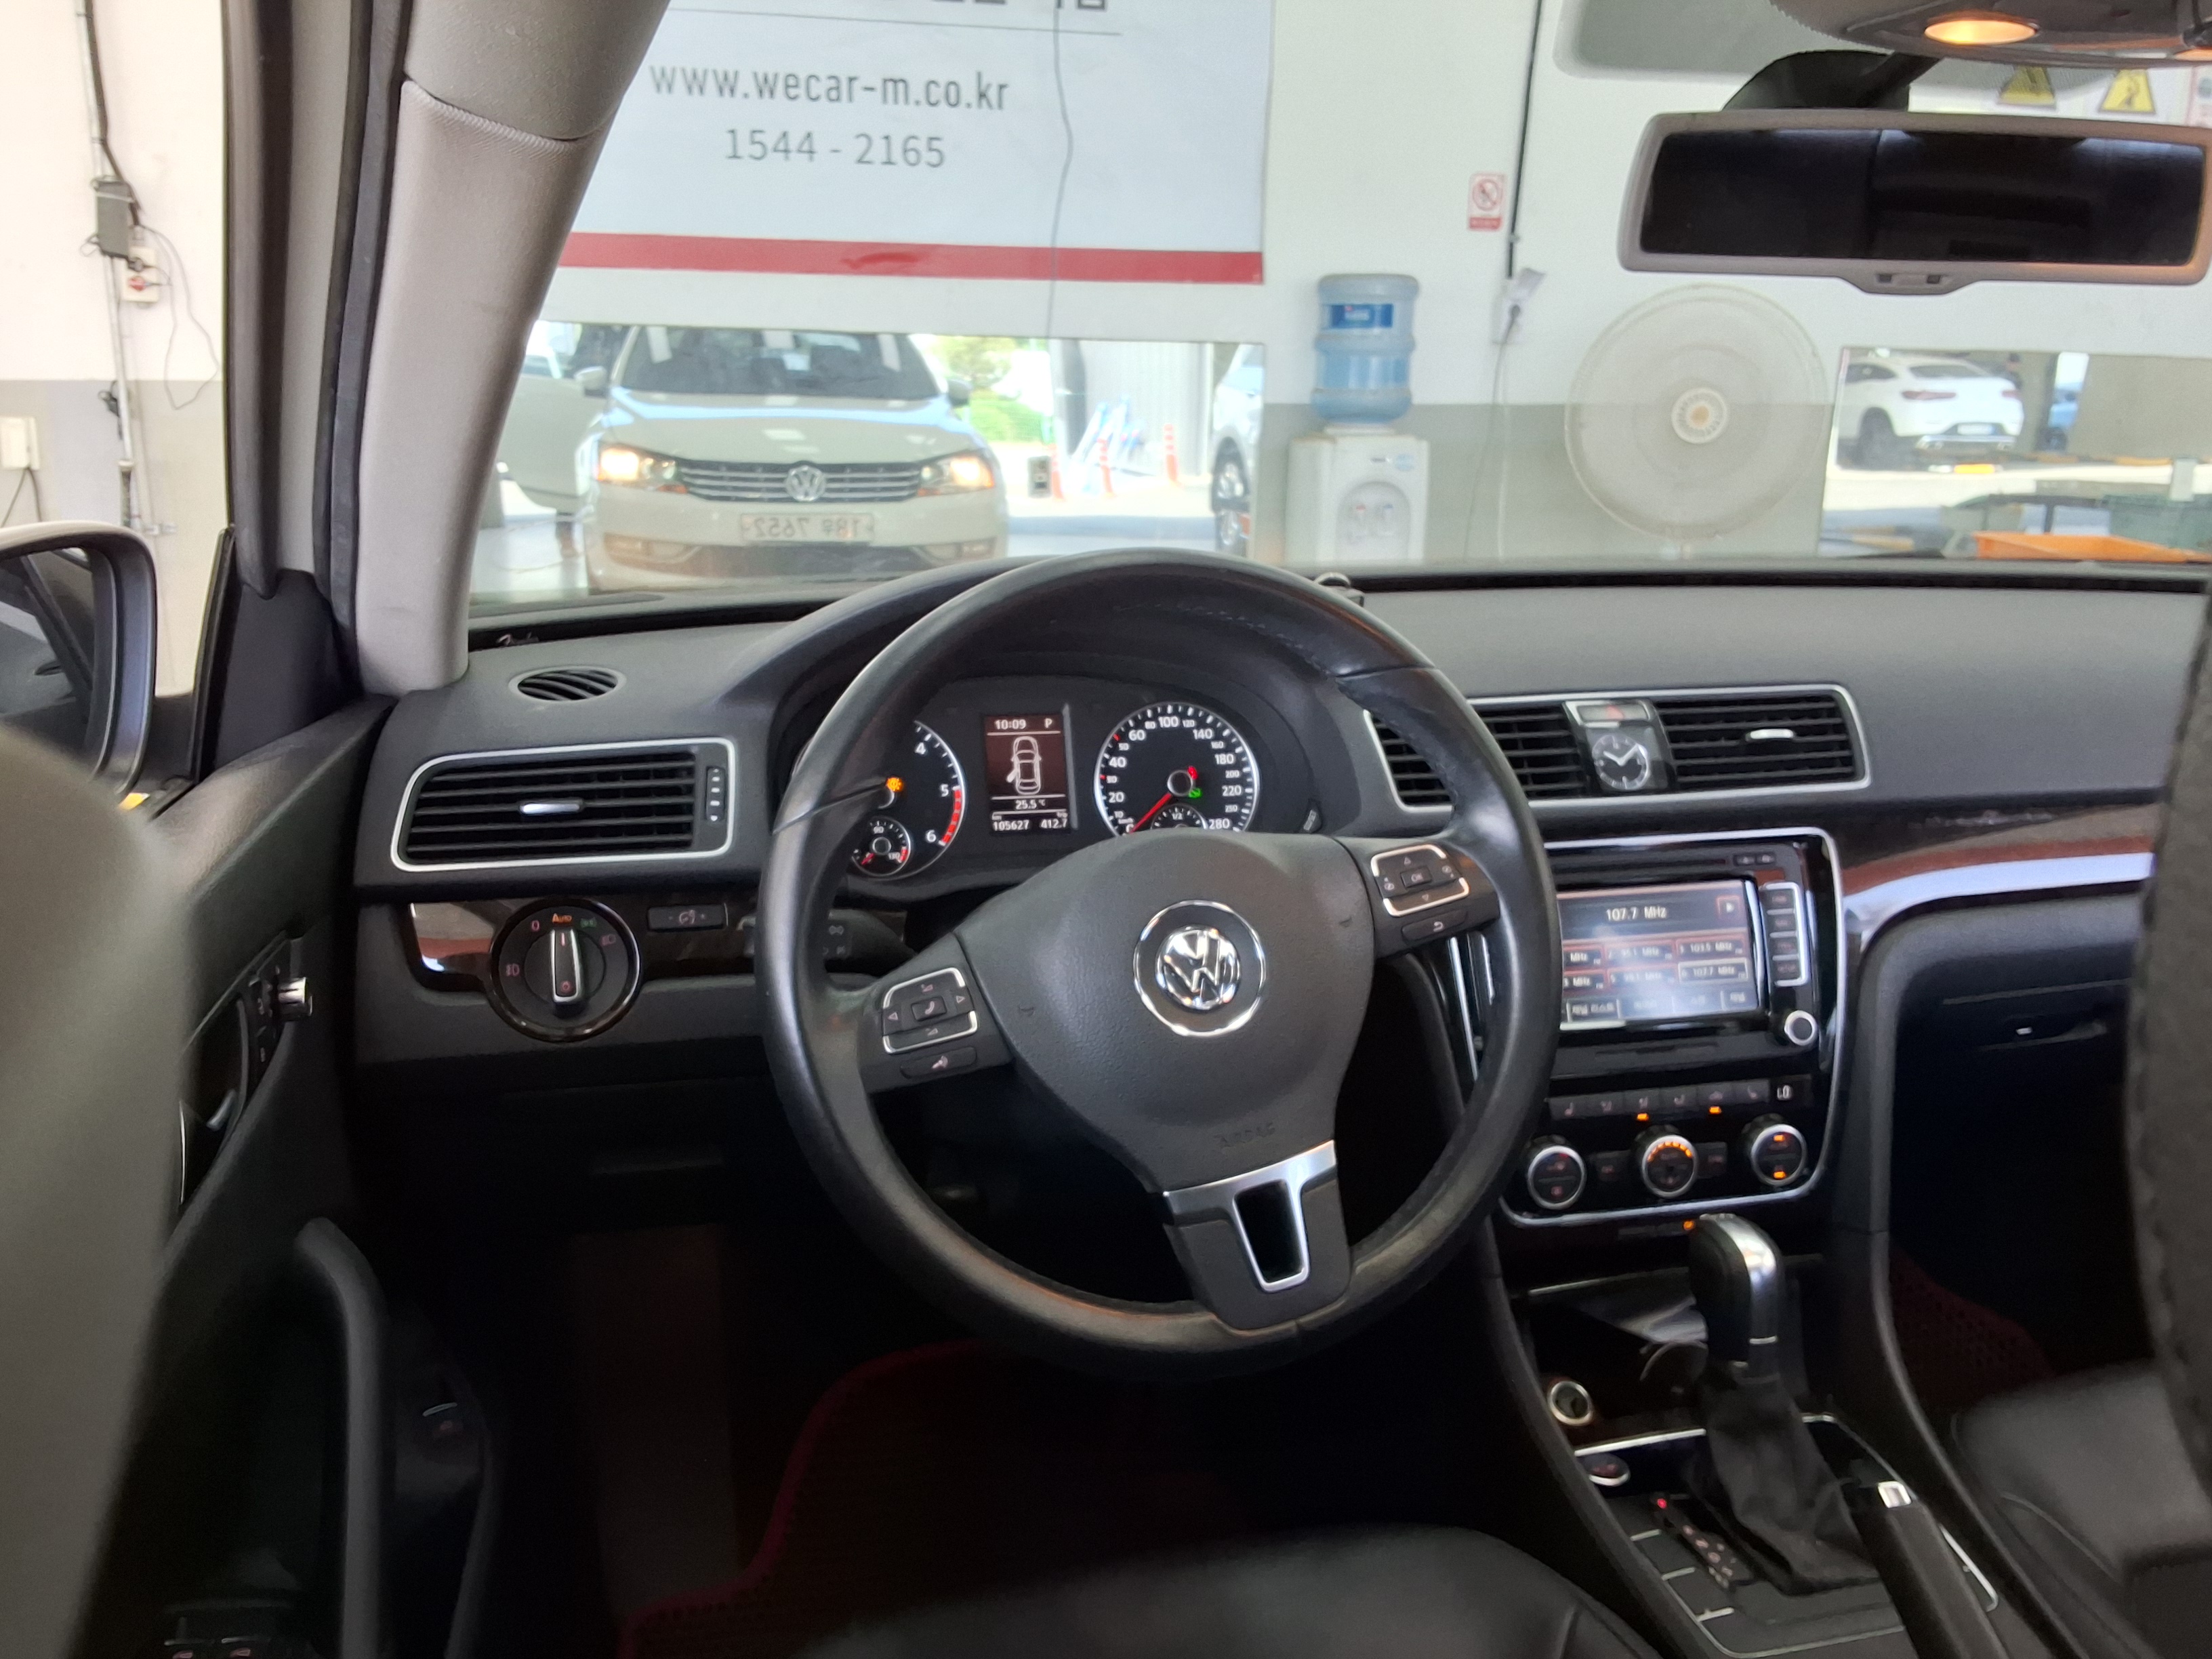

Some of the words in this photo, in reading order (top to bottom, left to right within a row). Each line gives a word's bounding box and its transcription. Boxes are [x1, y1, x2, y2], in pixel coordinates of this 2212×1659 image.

[649, 65, 1009, 110] www.wecar-m.co.kr
[725, 129, 817, 161] 1544
[854, 133, 945, 168] 2165
[994, 719, 1027, 730] 10:09
[1044, 718, 1052, 729] P
[1158, 716, 1179, 728] 100
[1183, 720, 1196, 728] 120
[1128, 730, 1146, 741] 60
[1193, 728, 1214, 739] 140
[915, 742, 926, 756] 4
[1109, 757, 1127, 768] 40
[1214, 754, 1235, 765] 180
[939, 784, 949, 796] 5
[1222, 785, 1242, 796] 220
[1109, 792, 1125, 803] 20
[1015, 799, 1037, 809] 25.5
[993, 819, 1030, 831] 105627
[1040, 818, 1068, 829] 412.7
[1208, 818, 1231, 830] 280
[925, 830, 937, 842] 6
[552, 913, 573, 923] Auto
[1605, 907, 1637, 922] 107.7
[1644, 905, 1667, 920] MHz
